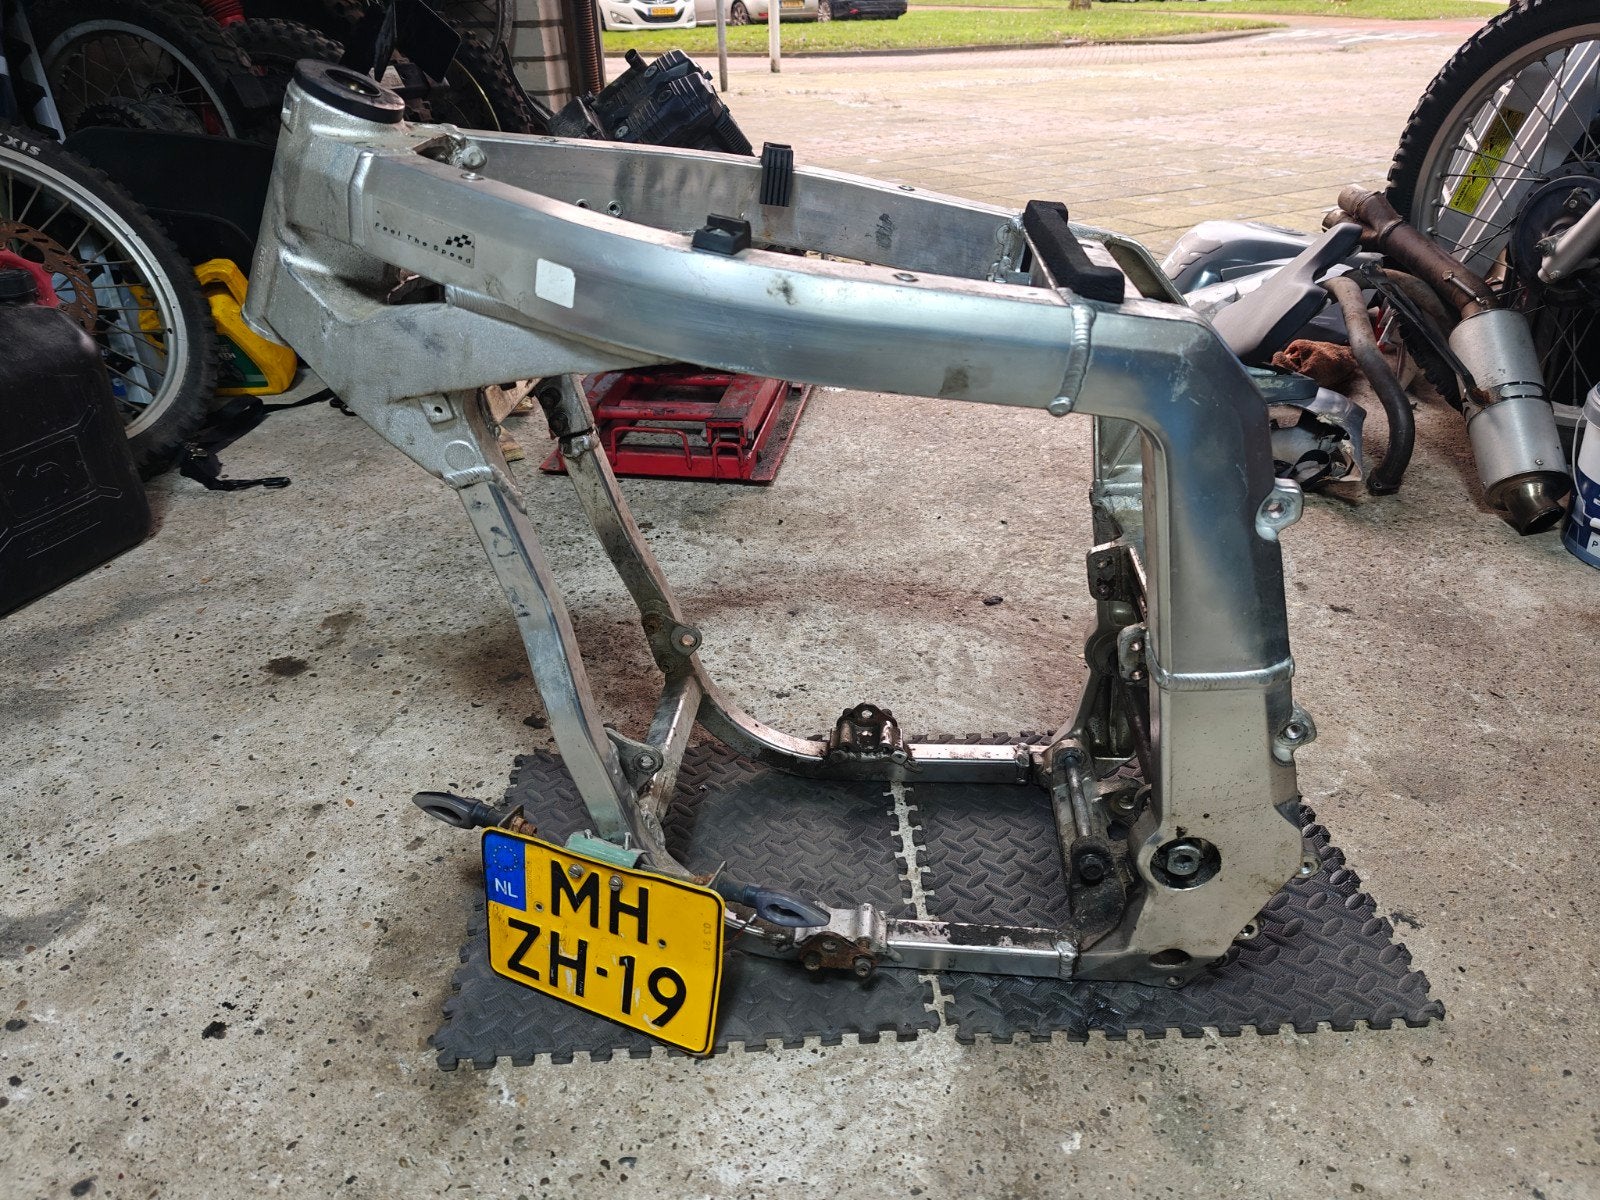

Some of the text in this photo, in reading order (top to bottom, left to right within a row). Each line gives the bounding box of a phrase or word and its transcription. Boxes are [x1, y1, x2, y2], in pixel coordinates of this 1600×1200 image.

[0, 133, 42, 156] XIS
[407, 234, 428, 247] The
[494, 876, 519, 899] NL
[551, 859, 649, 945] MH
[507, 916, 687, 1028] ZH-19
